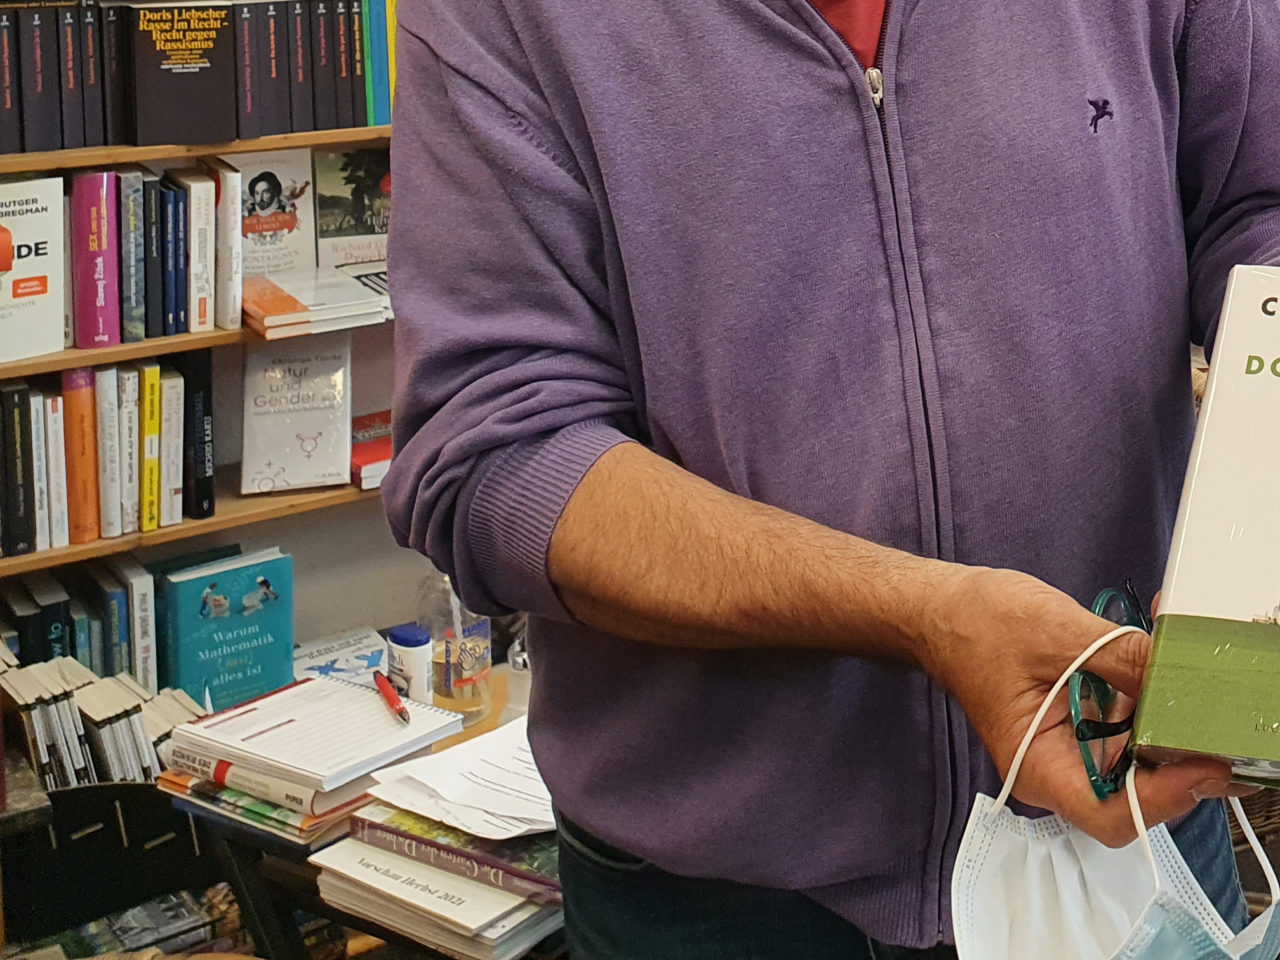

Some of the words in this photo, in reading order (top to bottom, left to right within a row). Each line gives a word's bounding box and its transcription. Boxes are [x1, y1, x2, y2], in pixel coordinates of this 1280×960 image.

[139, 10, 171, 21] Doris
[173, 8, 227, 21] Liebscher
[139, 19, 171, 31] Rasse
[190, 18, 221, 31] Recht
[152, 29, 182, 41] Recht
[185, 30, 216, 42] gegen
[155, 39, 214, 51] Rassismus
[264, 366, 309, 380] Natur
[269, 381, 300, 392] und
[254, 392, 316, 408] Gender
[213, 624, 260, 642] Warum
[198, 632, 275, 660] Mathematik
[247, 664, 262, 677] ist
[212, 671, 243, 686] alles
[357, 857, 401, 882] Vorschau
[437, 891, 467, 907] 2021
